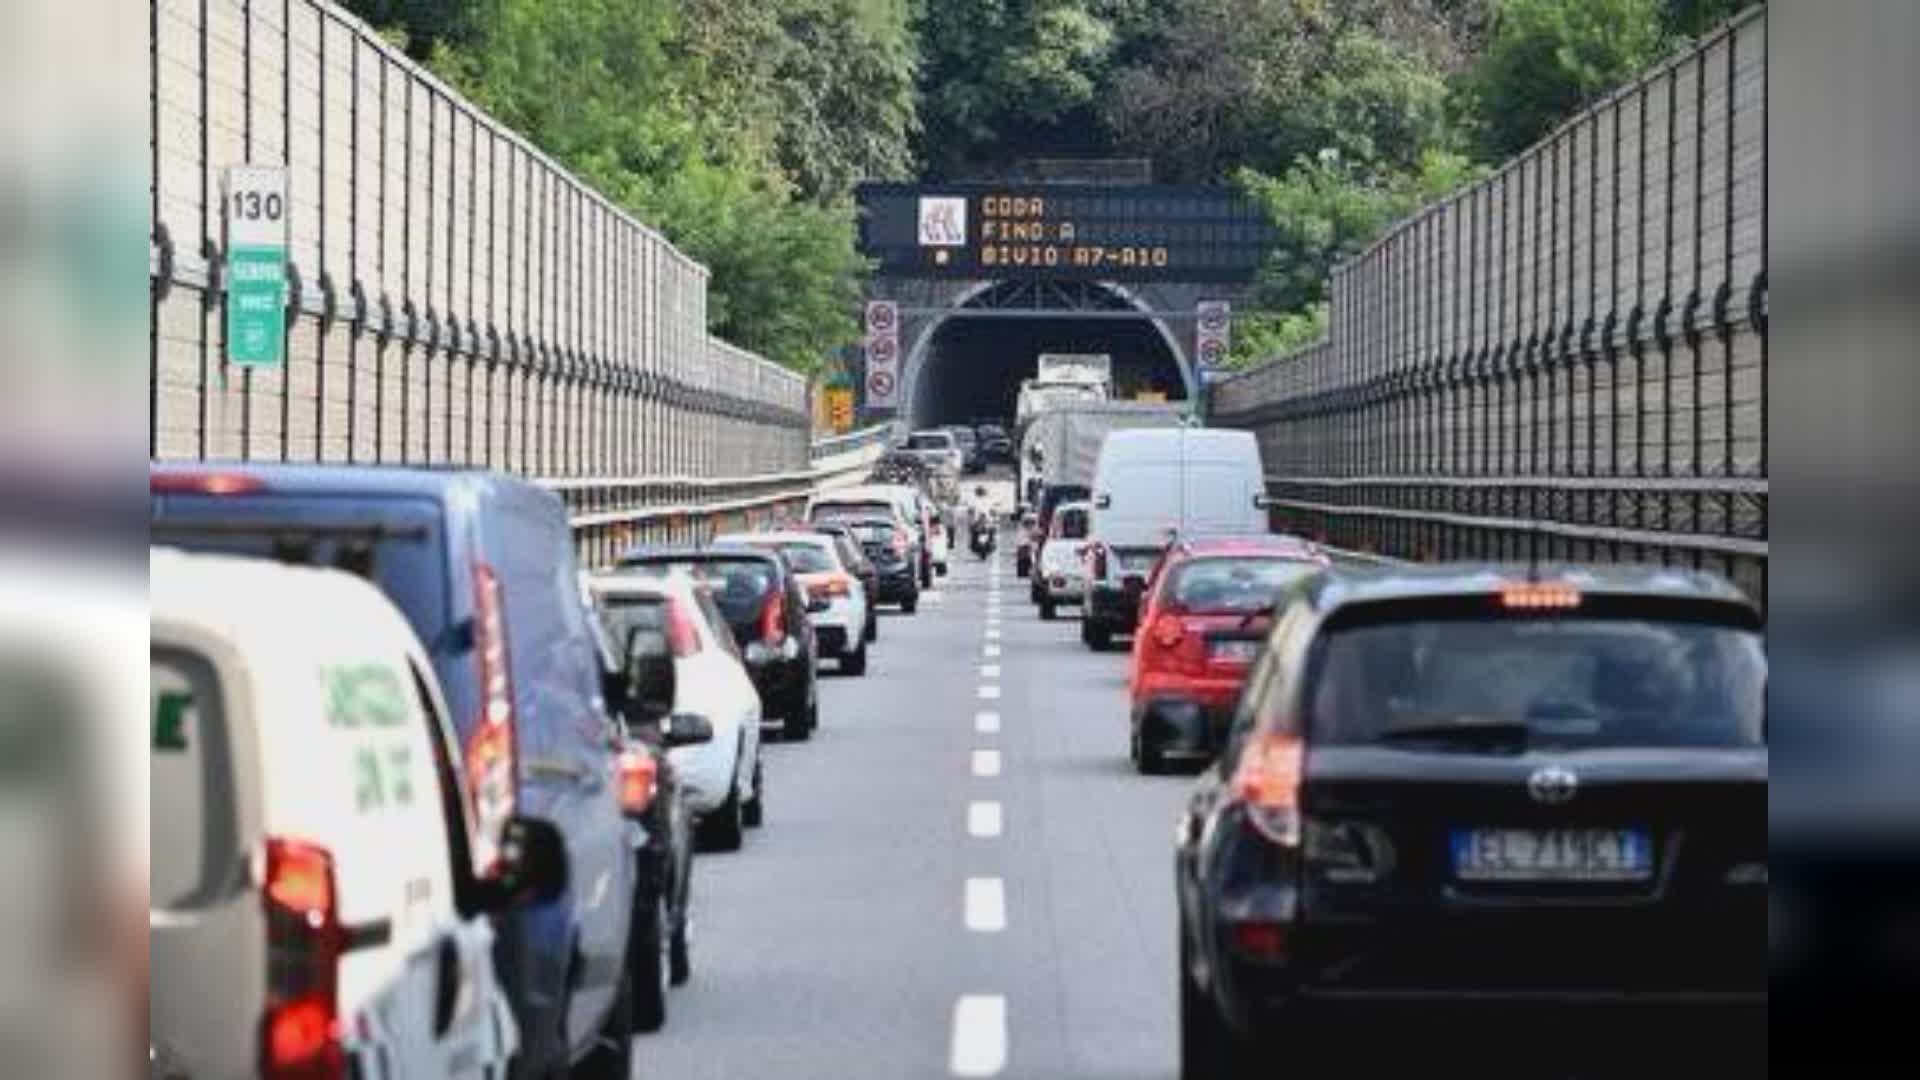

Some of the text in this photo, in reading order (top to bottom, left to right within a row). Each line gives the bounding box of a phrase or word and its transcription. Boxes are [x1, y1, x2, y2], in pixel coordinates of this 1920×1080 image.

[233, 191, 282, 221] 130
[982, 221, 1075, 241] FINO A
[981, 246, 1168, 267] BIVIO A7-A10
